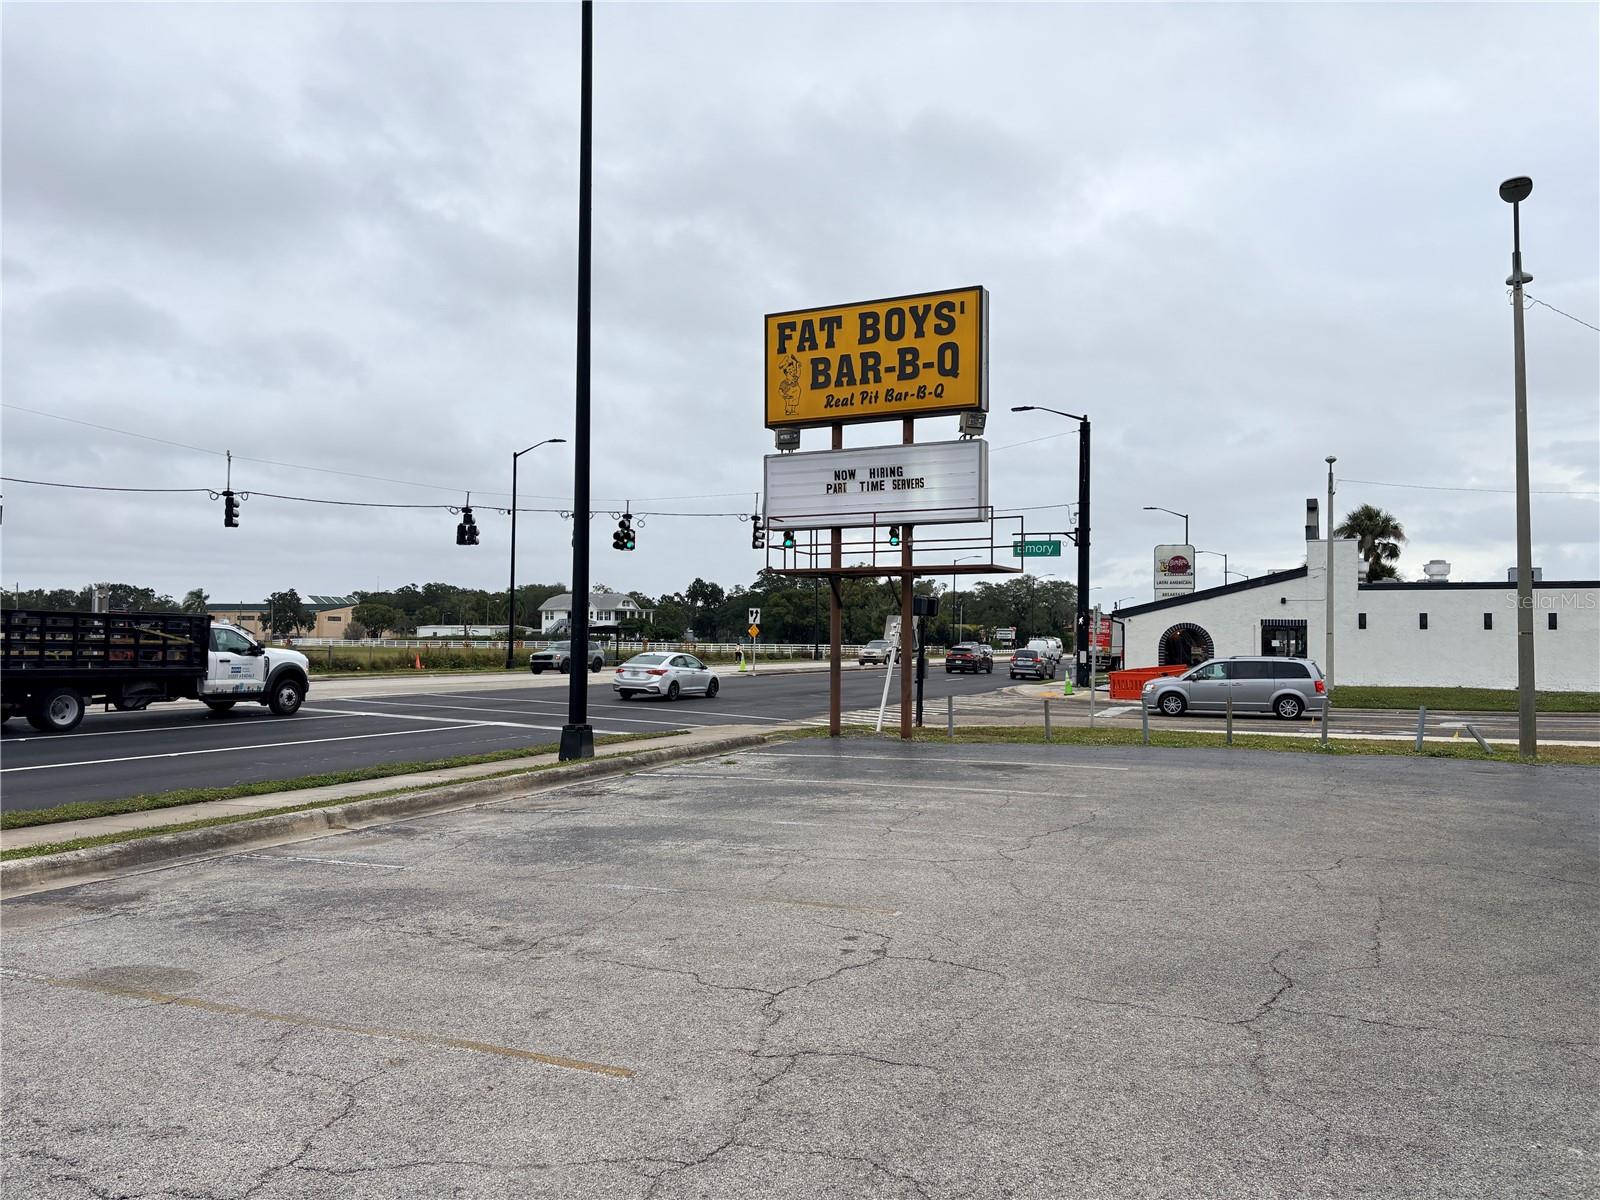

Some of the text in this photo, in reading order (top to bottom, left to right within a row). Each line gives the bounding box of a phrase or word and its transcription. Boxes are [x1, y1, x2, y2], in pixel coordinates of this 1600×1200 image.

[777, 300, 965, 355] FAT BOYS'
[810, 341, 960, 390] BAR-B-Q
[824, 383, 945, 409] Real Pit Bar-B-Q
[826, 477, 925, 494] PART TIME SERVERS
[834, 466, 903, 481] NOW HIRING
